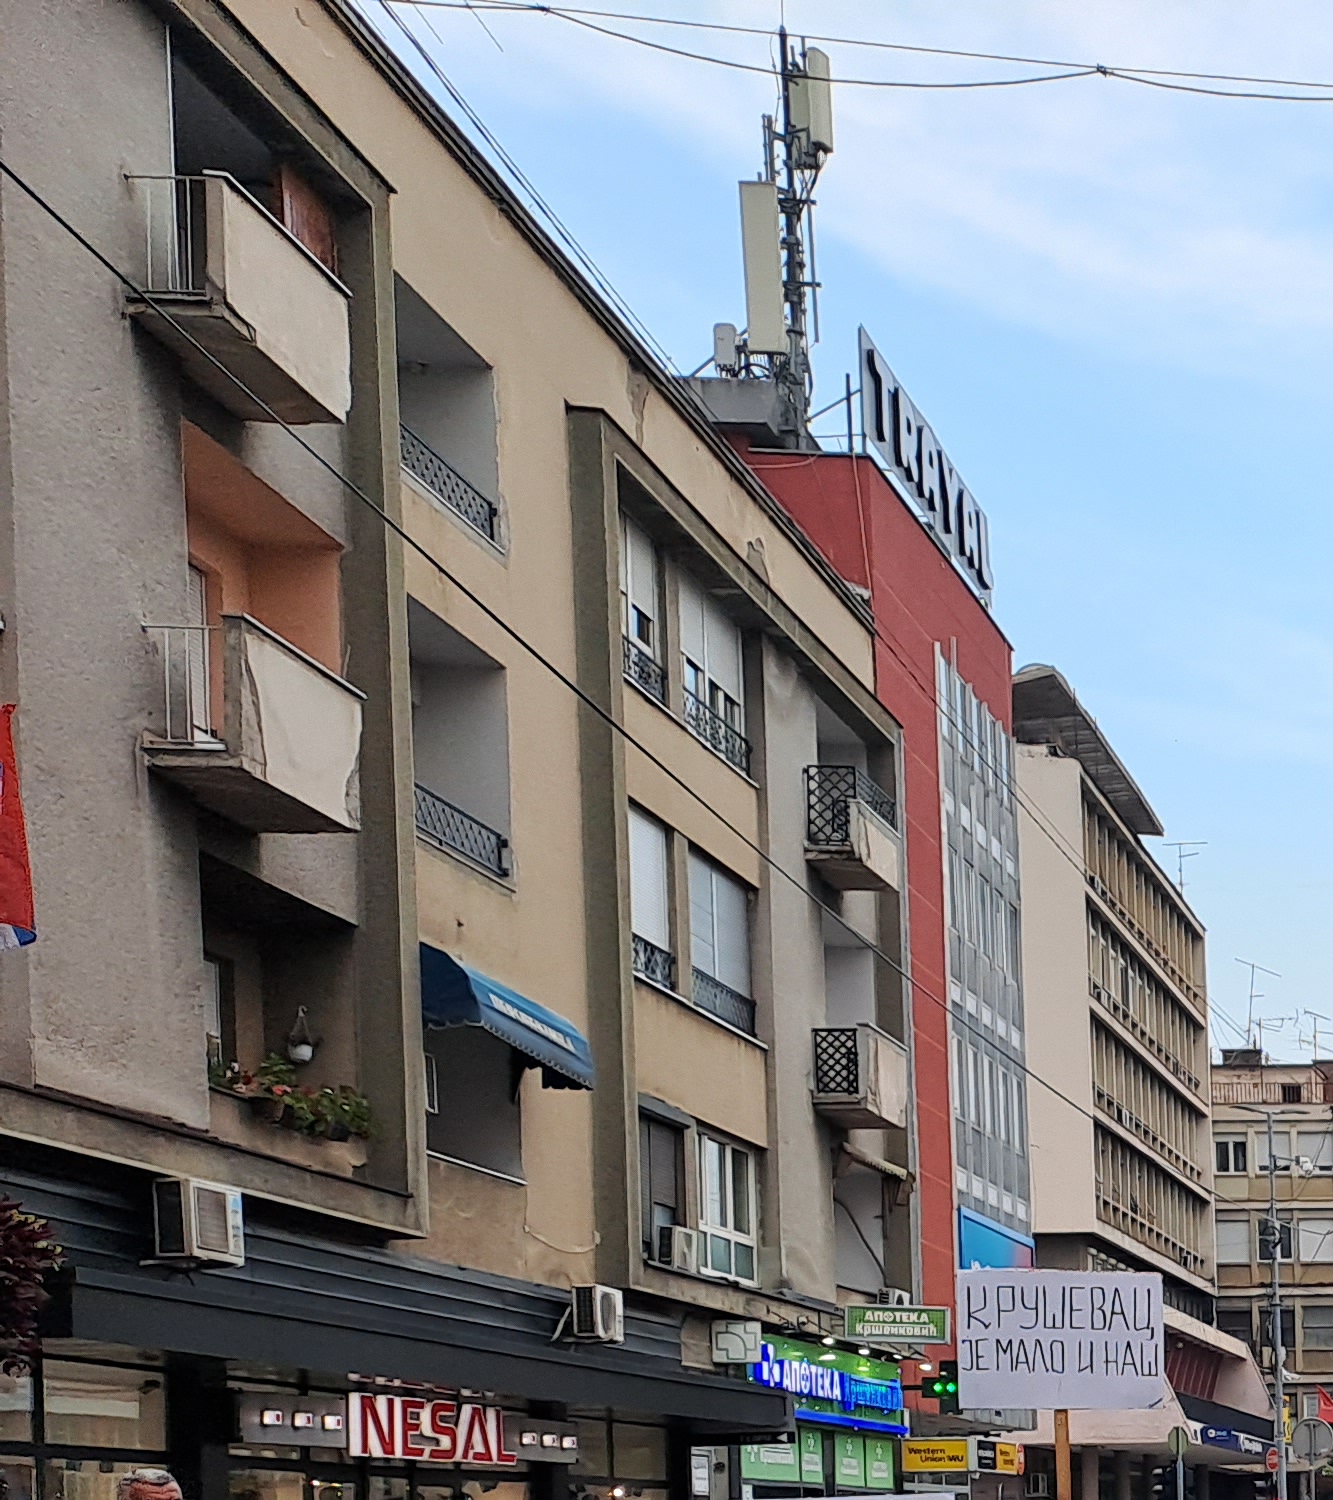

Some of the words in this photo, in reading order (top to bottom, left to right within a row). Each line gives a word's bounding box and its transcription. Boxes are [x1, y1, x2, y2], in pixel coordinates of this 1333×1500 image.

[866, 348, 994, 591] TRAYAL
[863, 1310, 930, 1323] АПОТЕКА
[966, 1284, 1156, 1340] КРУШЕВАЦ
[961, 1337, 990, 1371] ЈЕ
[995, 1338, 1065, 1374] МАЛО
[1077, 1339, 1094, 1375] И
[1103, 1340, 1159, 1377] НАШ
[782, 1359, 842, 1401] АПОТЕКА
[350, 1393, 518, 1465] NESAL
[907, 1447, 945, 1456] Western
[920, 1455, 946, 1463] Union
